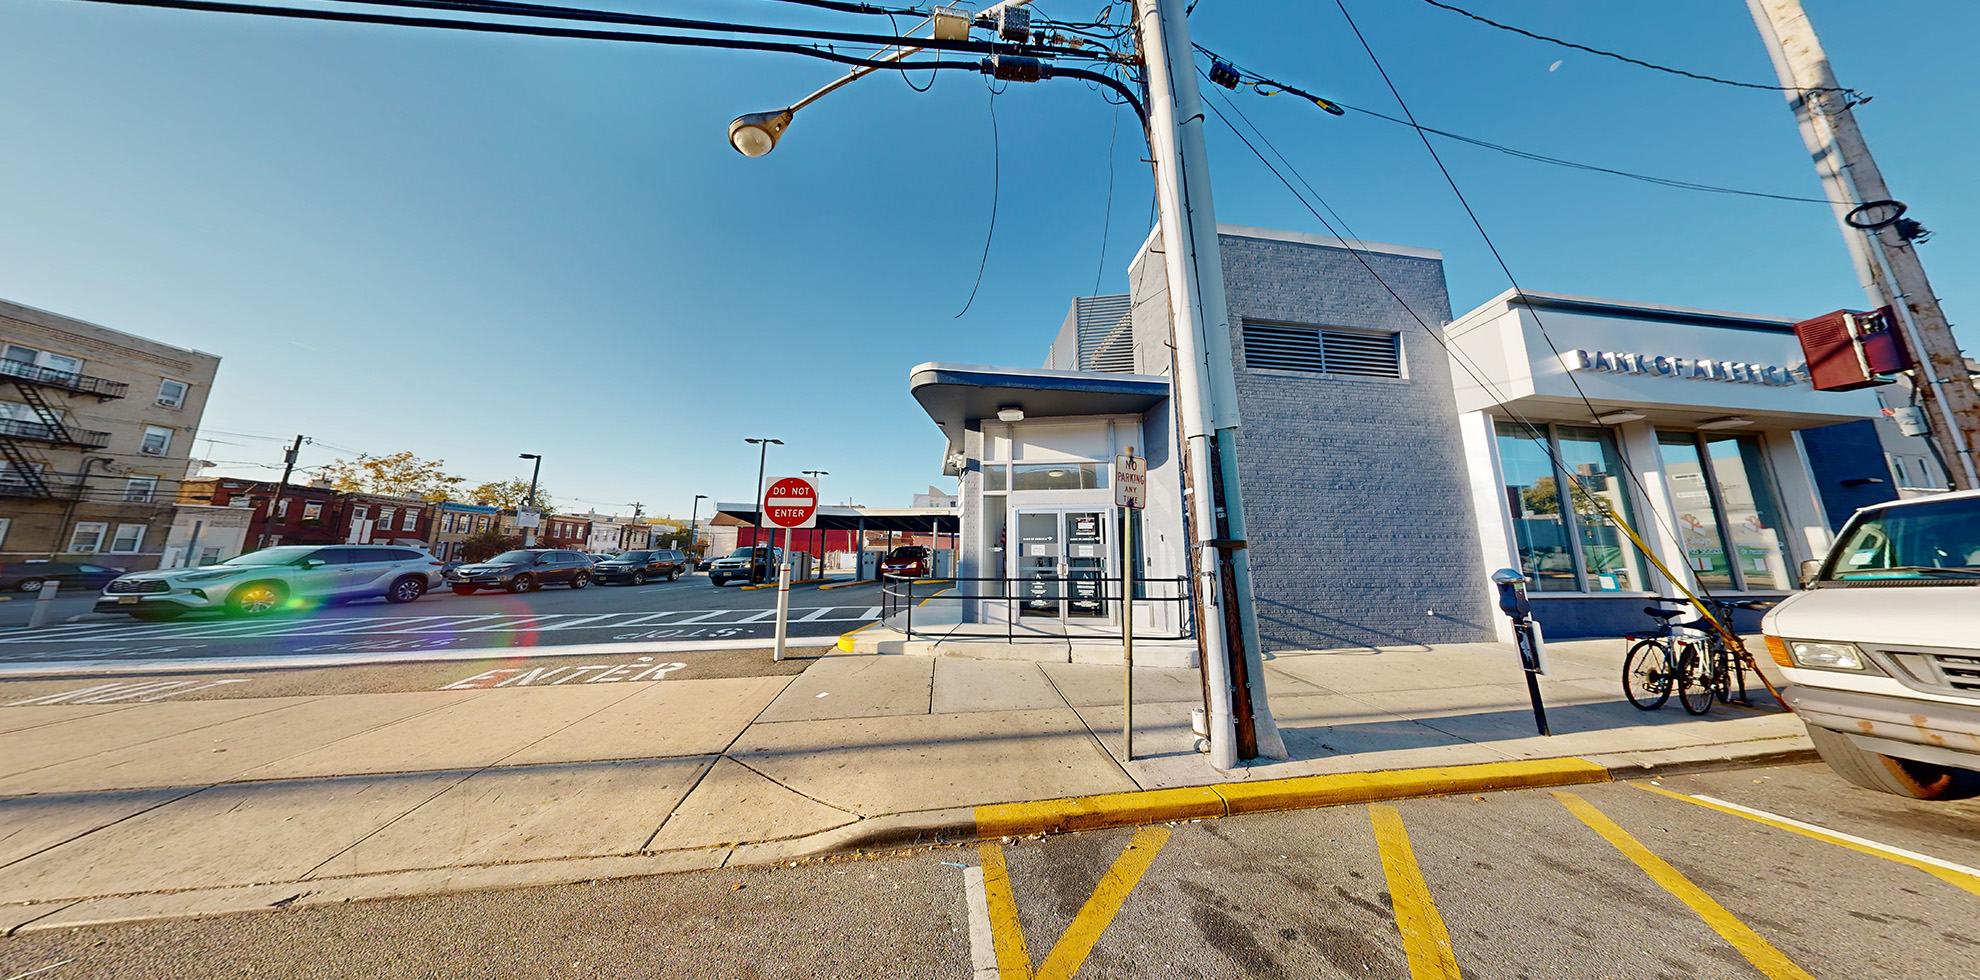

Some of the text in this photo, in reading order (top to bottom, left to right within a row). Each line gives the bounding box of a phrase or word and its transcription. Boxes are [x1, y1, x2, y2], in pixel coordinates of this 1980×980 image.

[1568, 349, 1797, 387] BANK OF AMERICA
[1125, 460, 1137, 471] NO
[1117, 471, 1145, 485] PARKING
[773, 486, 810, 496] DO NOT
[774, 509, 805, 518] ENTER
[612, 628, 743, 640] STOP
[437, 662, 688, 690] ENTER
